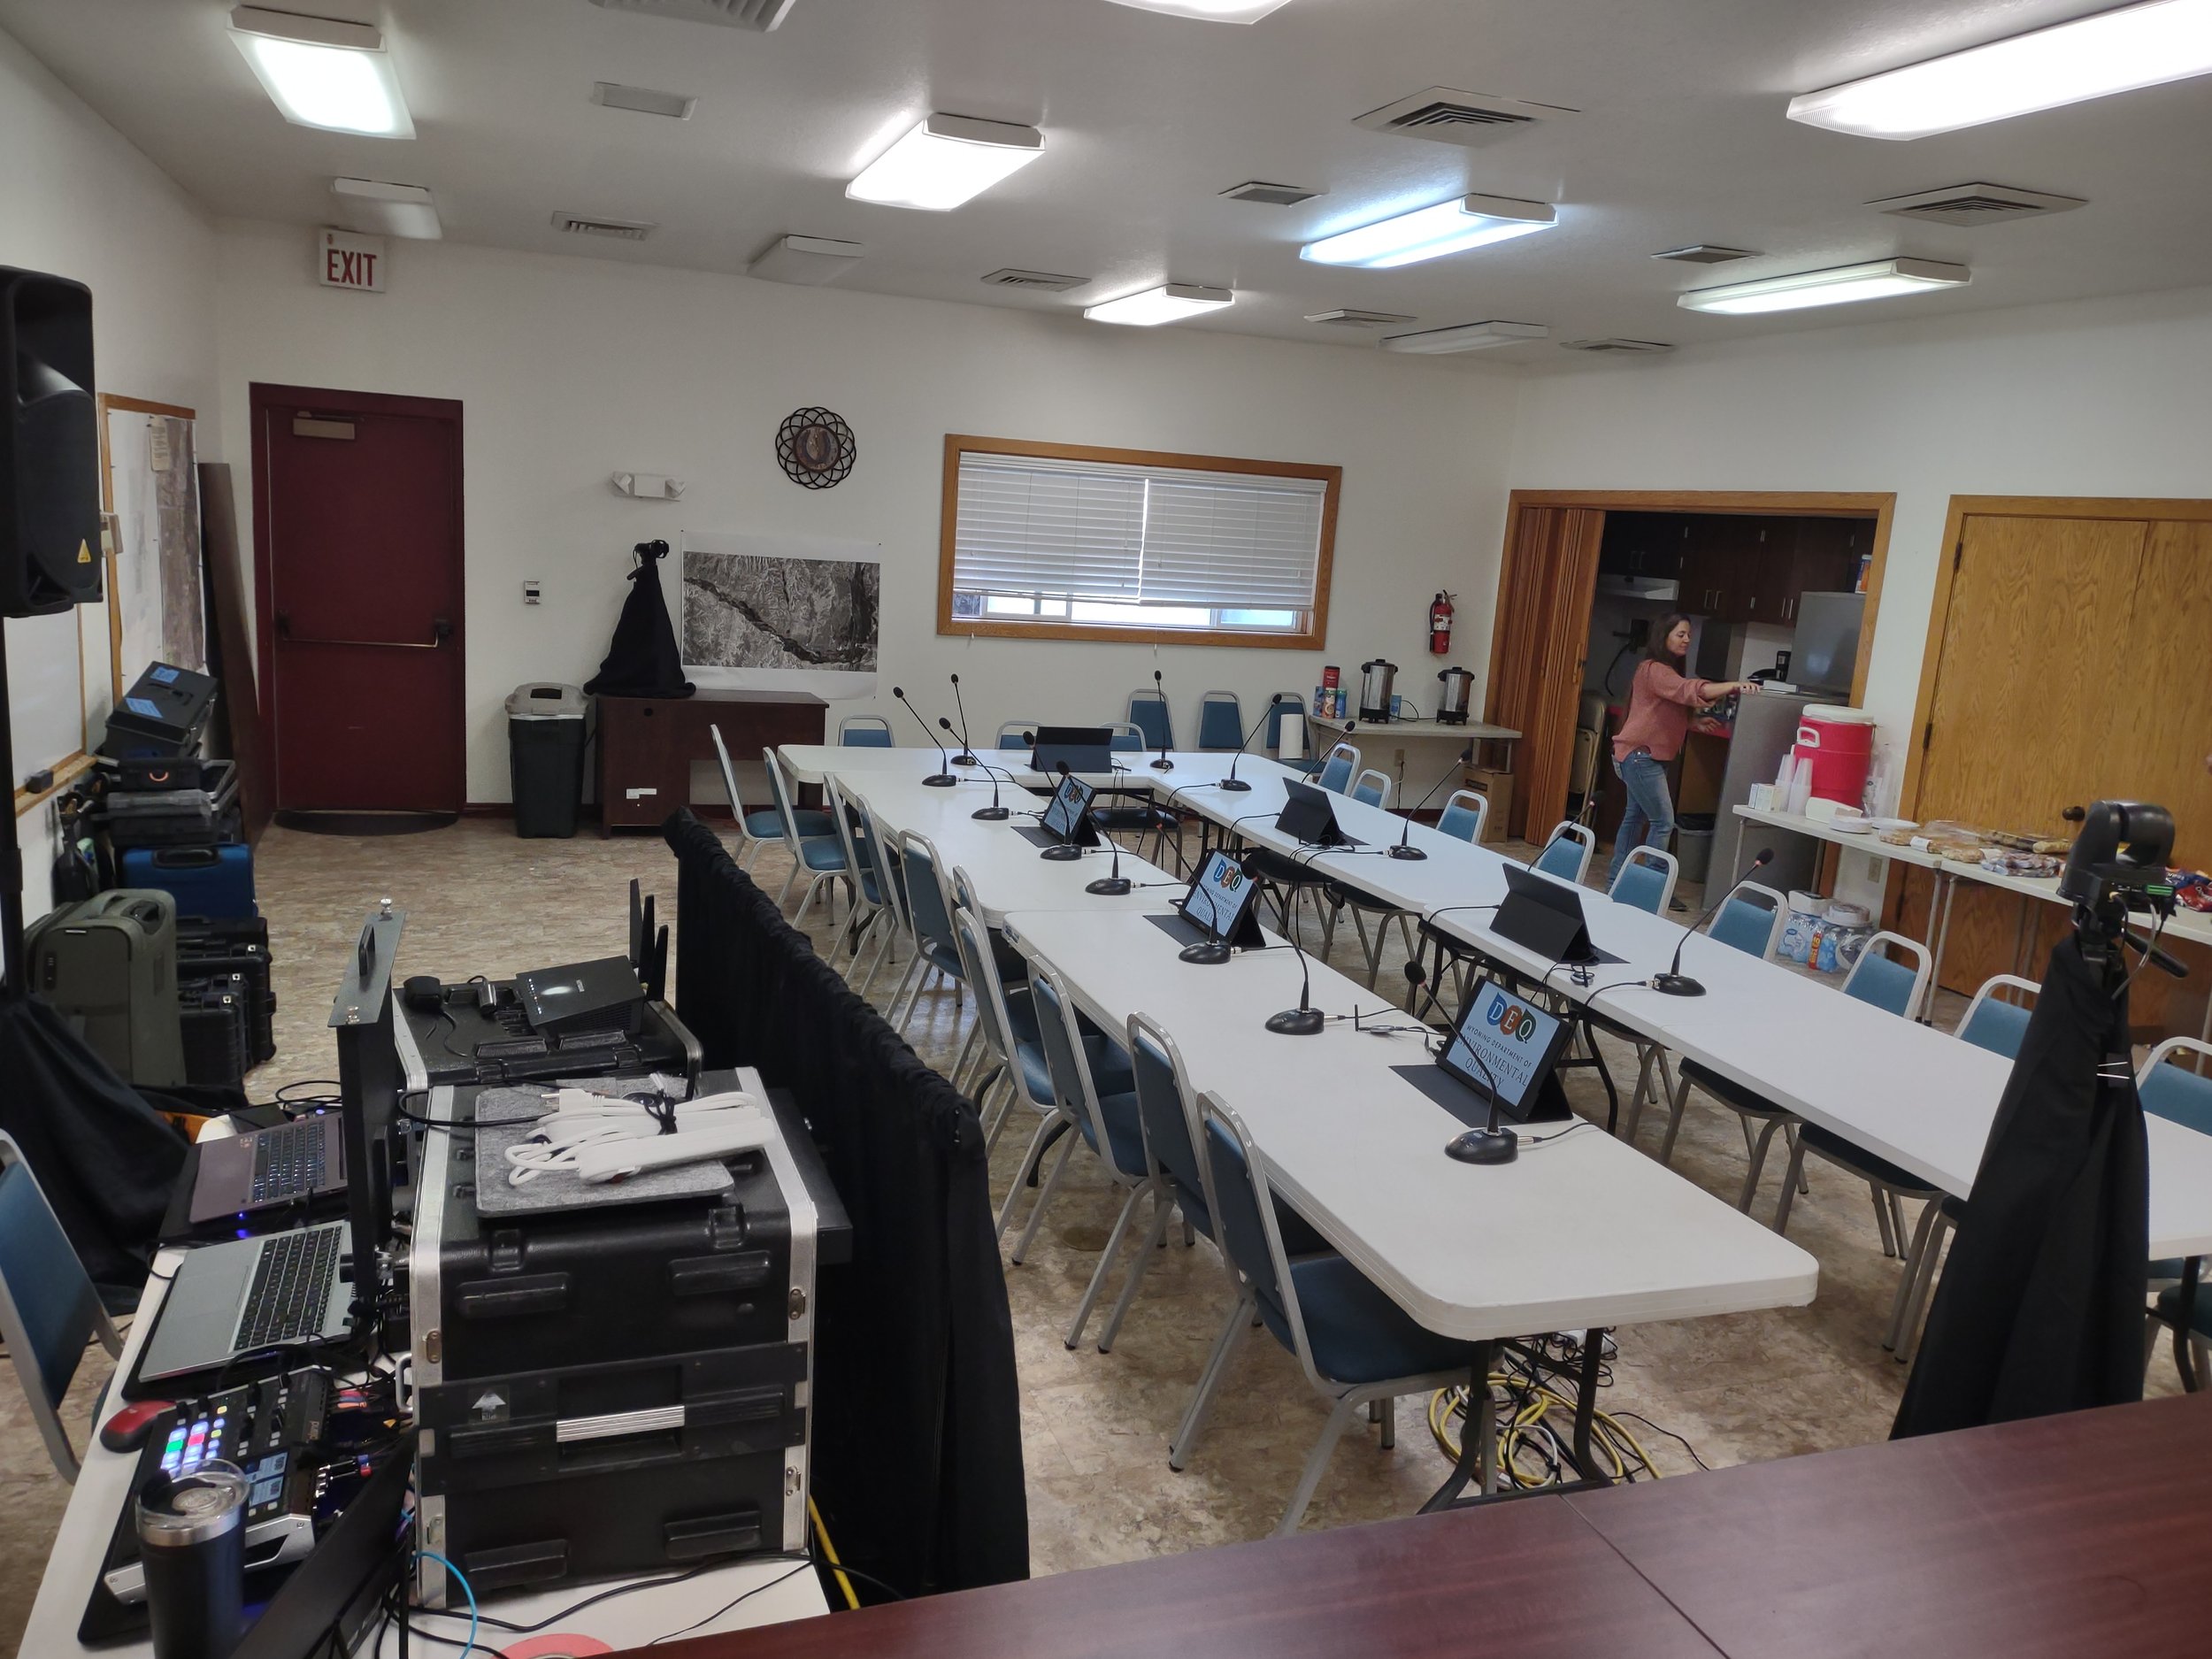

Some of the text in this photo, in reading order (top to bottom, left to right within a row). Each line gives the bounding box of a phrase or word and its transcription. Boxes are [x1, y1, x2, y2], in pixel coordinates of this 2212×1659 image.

[327, 249, 377, 287] EXIT
[1214, 864, 1240, 892] DEQ
[1488, 999, 1533, 1043] DEQ
[1466, 1025, 1532, 1068] WYOMING DEPARTMENT OF
